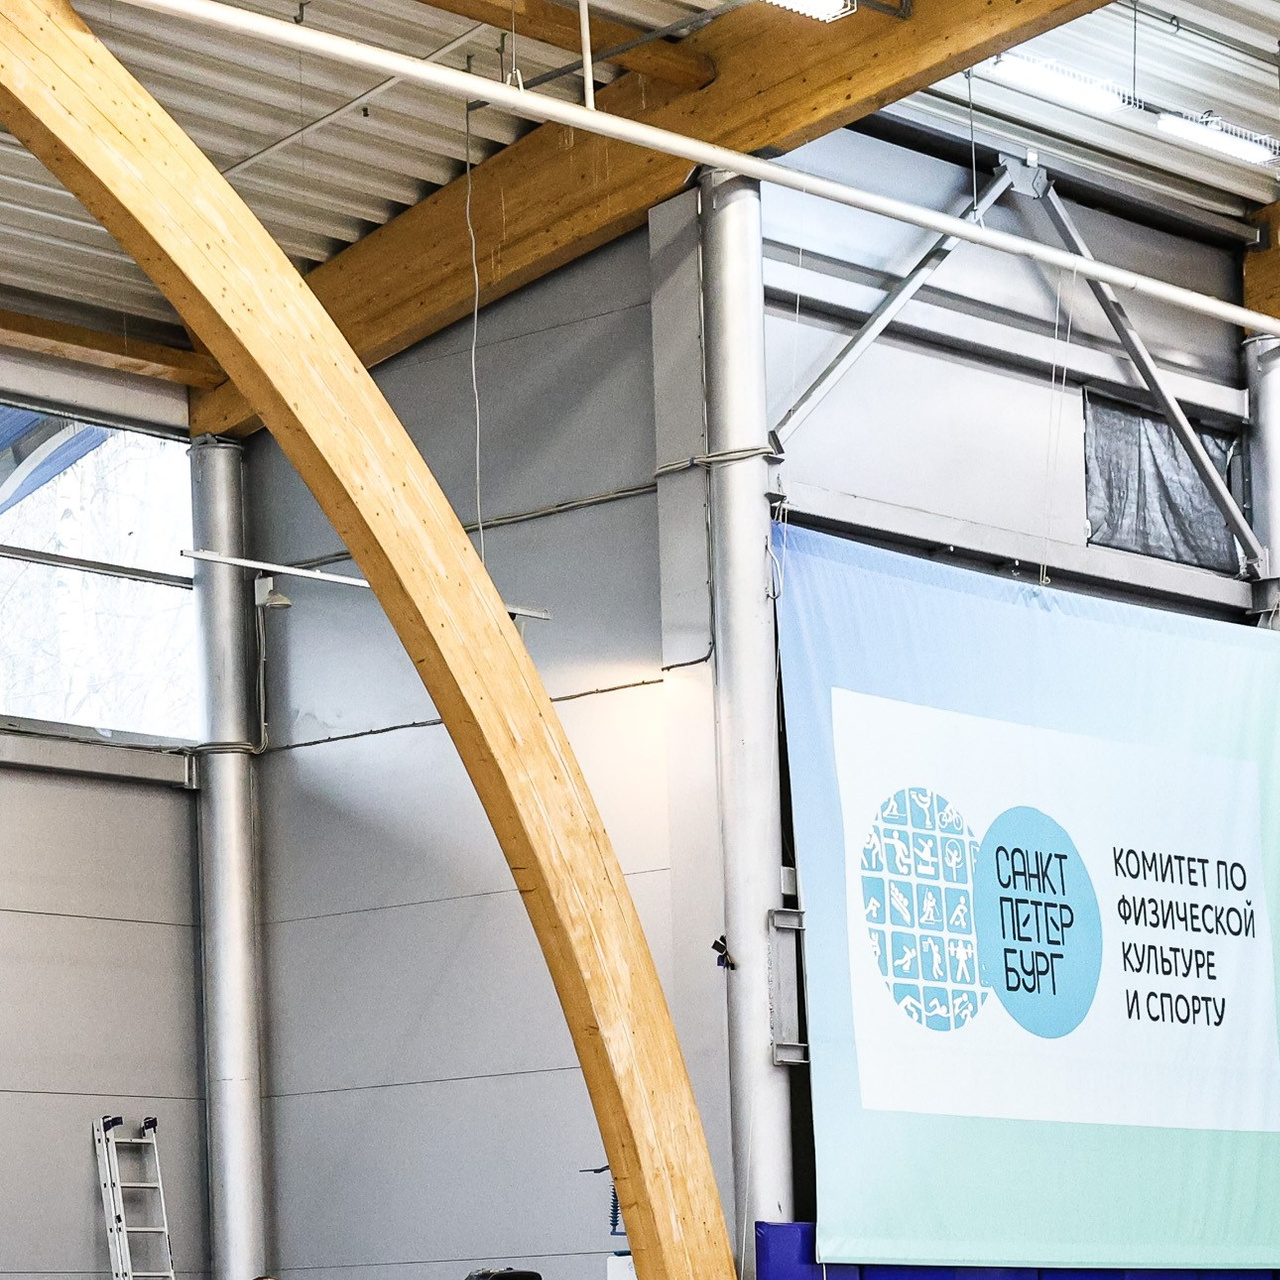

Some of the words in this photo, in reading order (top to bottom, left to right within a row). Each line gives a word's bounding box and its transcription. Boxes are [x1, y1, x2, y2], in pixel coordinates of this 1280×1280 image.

[995, 845, 1068, 896] САНКТ
[1112, 846, 1210, 888] КОМИТЕТ
[1216, 860, 1247, 891] ПО
[999, 896, 1074, 946] ПЕТЕР
[1117, 894, 1256, 939] ФИЗИЧЕСКОЙ
[1003, 947, 1064, 996] БУРГ
[1121, 941, 1217, 981] КУЛЬТУРЕ
[1125, 989, 1140, 1020] И
[1146, 991, 1226, 1027] СПОРТУ
